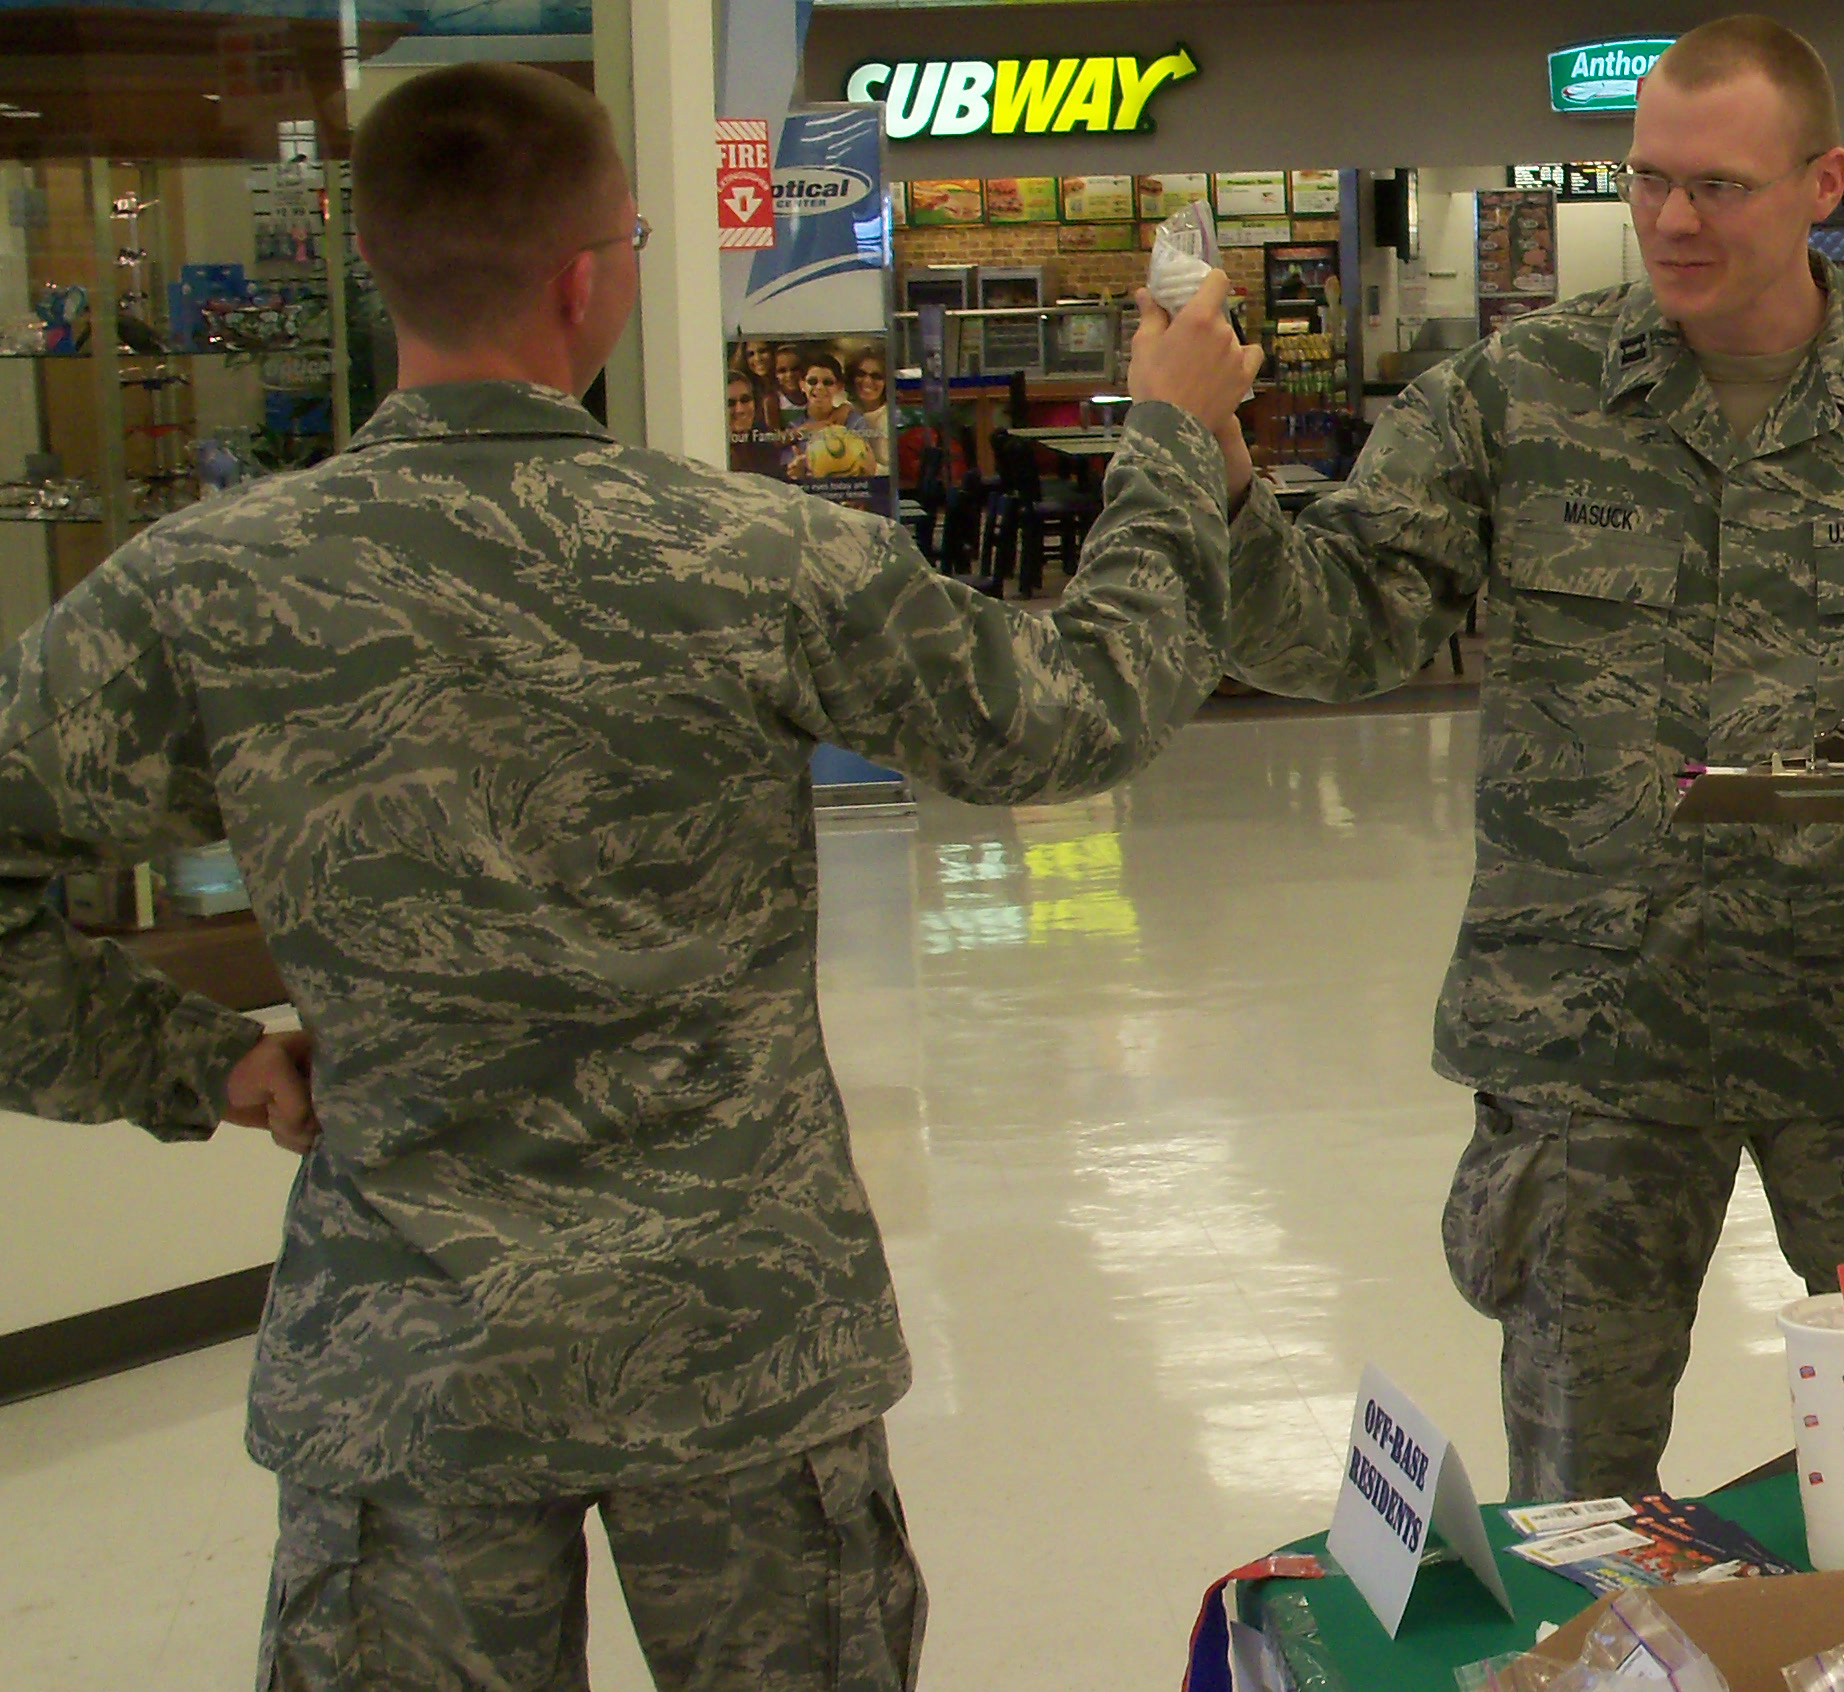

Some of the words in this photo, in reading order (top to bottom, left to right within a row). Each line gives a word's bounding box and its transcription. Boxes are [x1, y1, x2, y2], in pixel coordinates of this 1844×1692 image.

[847, 49, 1197, 138] SUBWAY
[716, 144, 769, 169] FIRE
[771, 179, 849, 198] ptical
[776, 199, 827, 209] CETER
[1563, 501, 1633, 531] MASUCK
[1364, 1399, 1429, 1492] OFF-BASE
[1349, 1445, 1423, 1554] RESIDENTS
